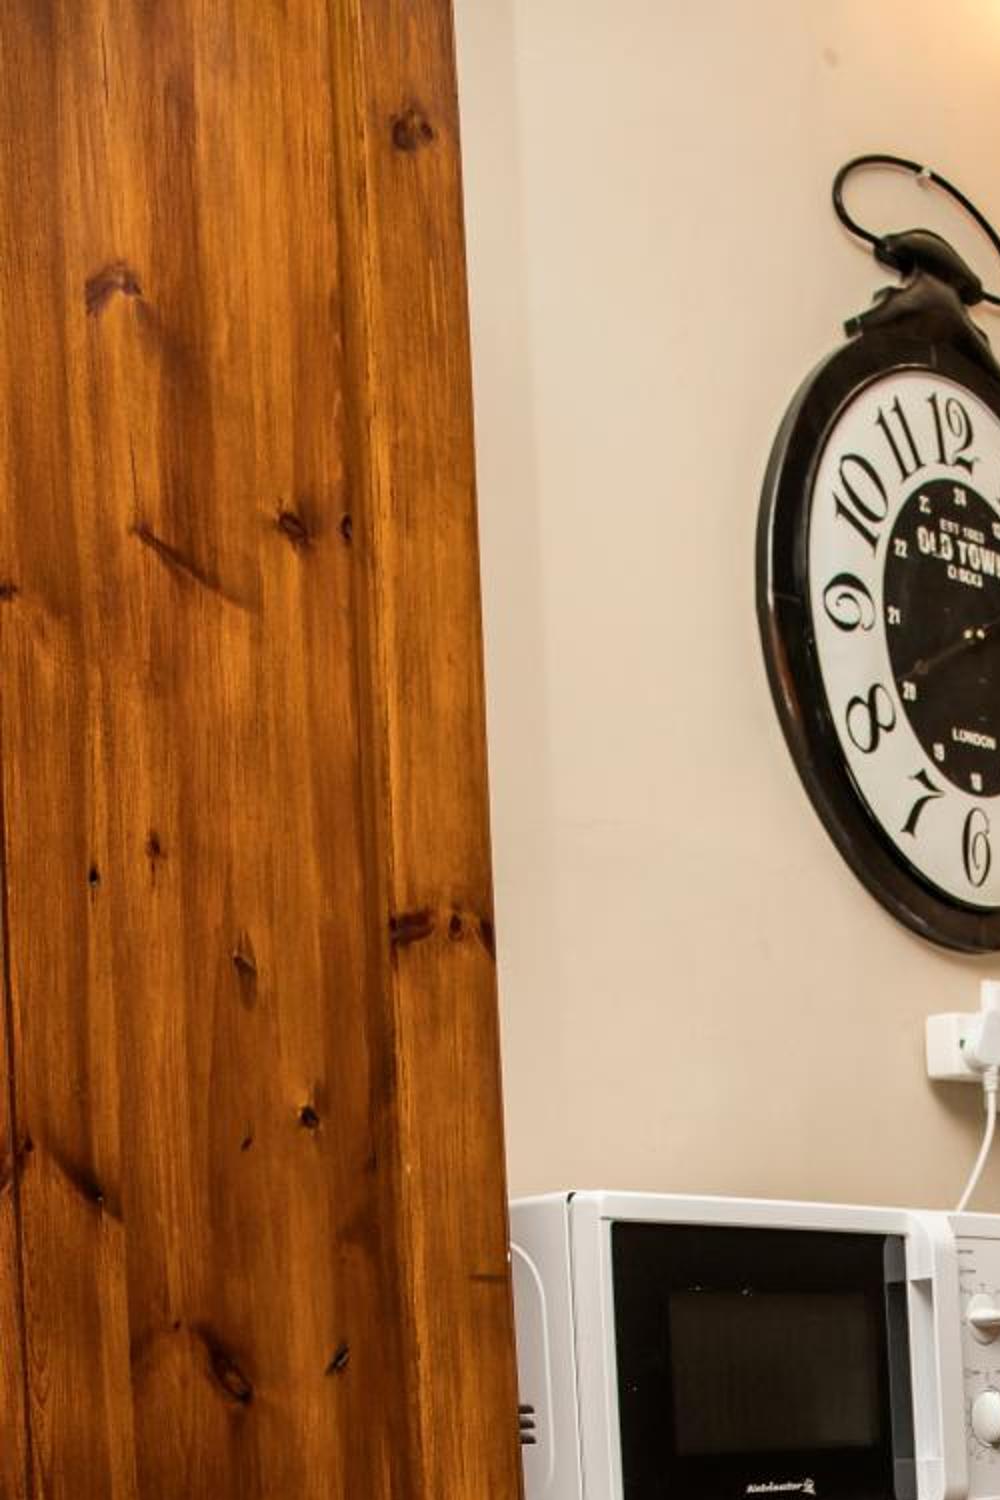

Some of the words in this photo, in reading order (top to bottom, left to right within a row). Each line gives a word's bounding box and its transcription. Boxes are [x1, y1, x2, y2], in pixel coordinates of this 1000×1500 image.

[876, 395, 925, 485] 11
[927, 391, 981, 474] 12
[833, 453, 889, 558] 10
[917, 526, 953, 561] OLD
[823, 572, 876, 632] 9
[845, 682, 896, 755] 8
[952, 727, 996, 750] LONDON
[901, 769, 944, 837] 7
[962, 806, 991, 888] 6
